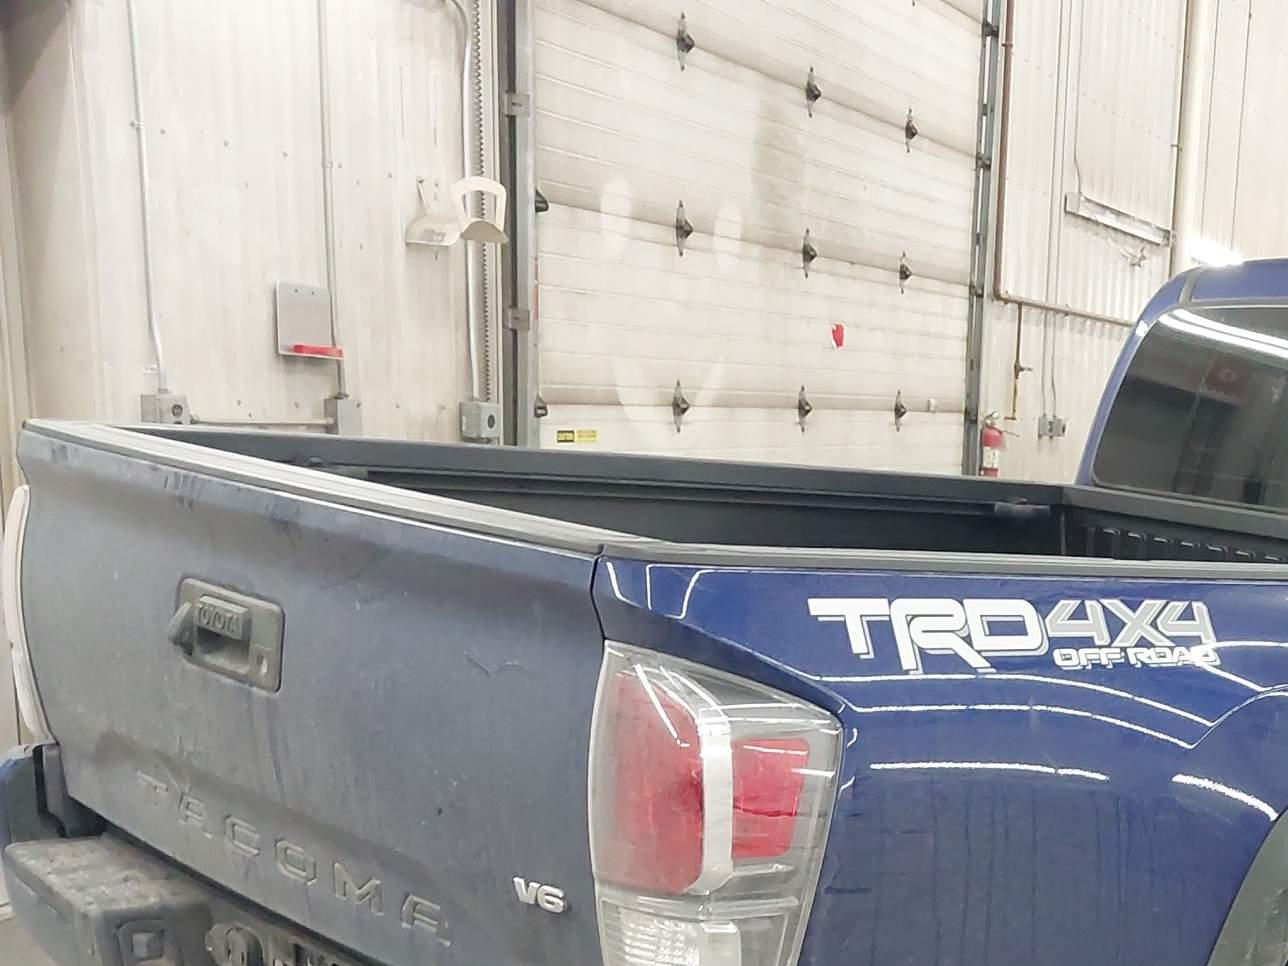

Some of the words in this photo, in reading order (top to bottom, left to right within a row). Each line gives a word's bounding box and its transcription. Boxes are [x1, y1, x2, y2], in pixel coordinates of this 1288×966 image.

[807, 598, 1050, 675] TRD
[1053, 648, 1124, 670] OFF
[1126, 647, 1221, 669] ROAD
[512, 876, 567, 913] V6
